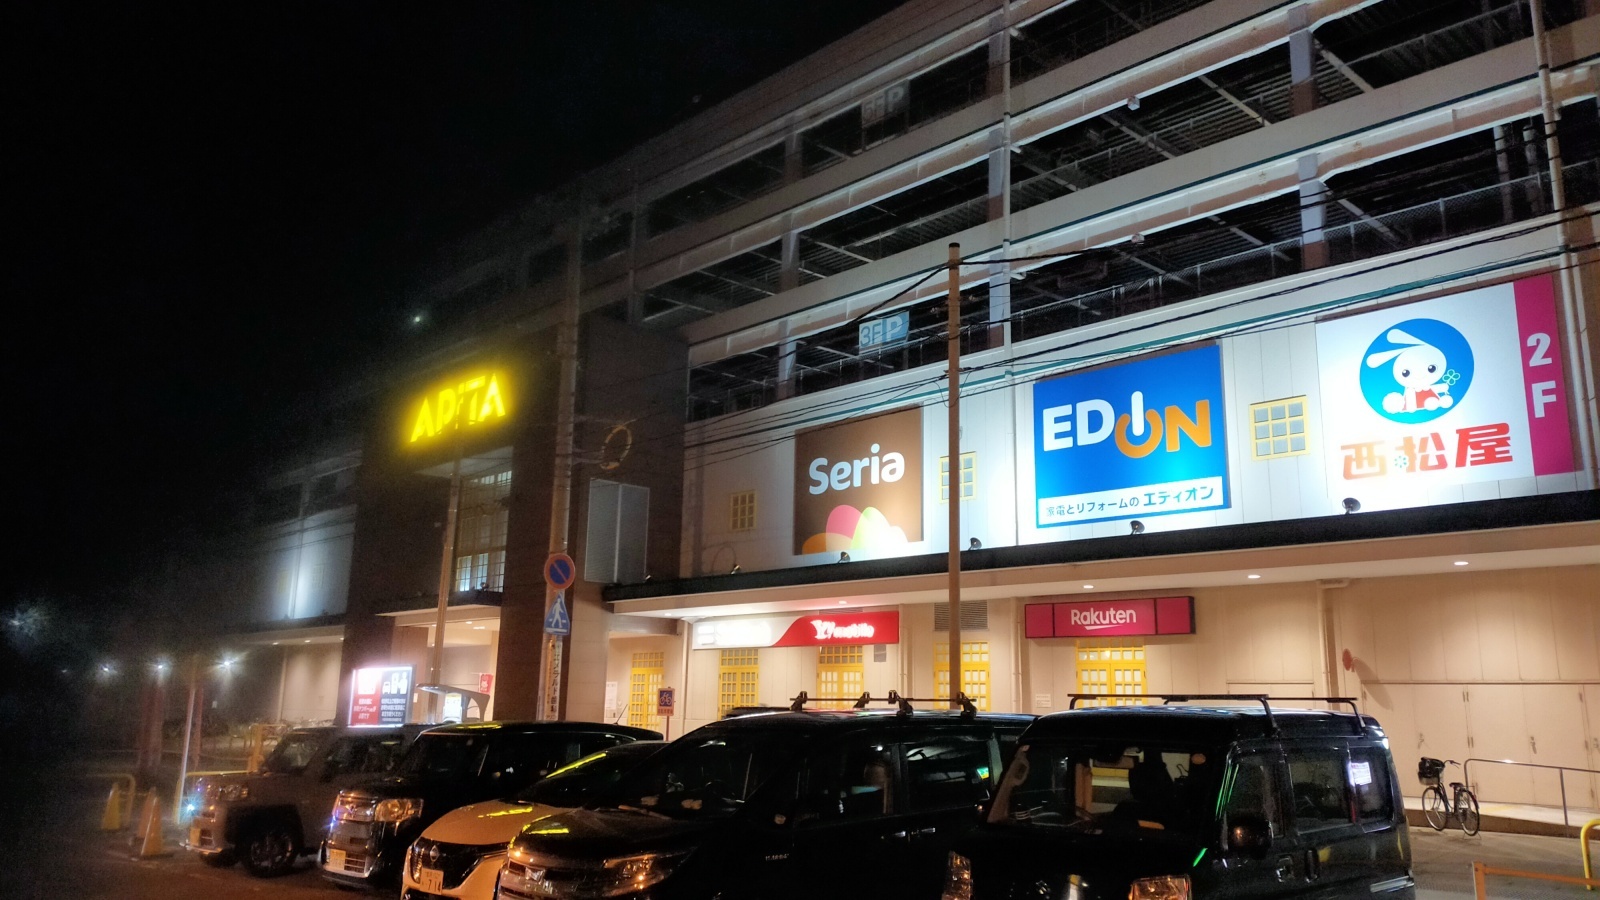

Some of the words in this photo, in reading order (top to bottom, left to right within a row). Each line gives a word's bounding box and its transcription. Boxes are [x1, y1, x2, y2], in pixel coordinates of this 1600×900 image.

[888, 87, 904, 112] P
[861, 322, 881, 347] 3F
[887, 315, 903, 341] P
[1043, 391, 1212, 459] EDION
[1340, 422, 1514, 481] 西松屋
[809, 443, 905, 495] Seria
[1143, 486, 1214, 507] エディオン
[1070, 607, 1137, 626] Rakuten
